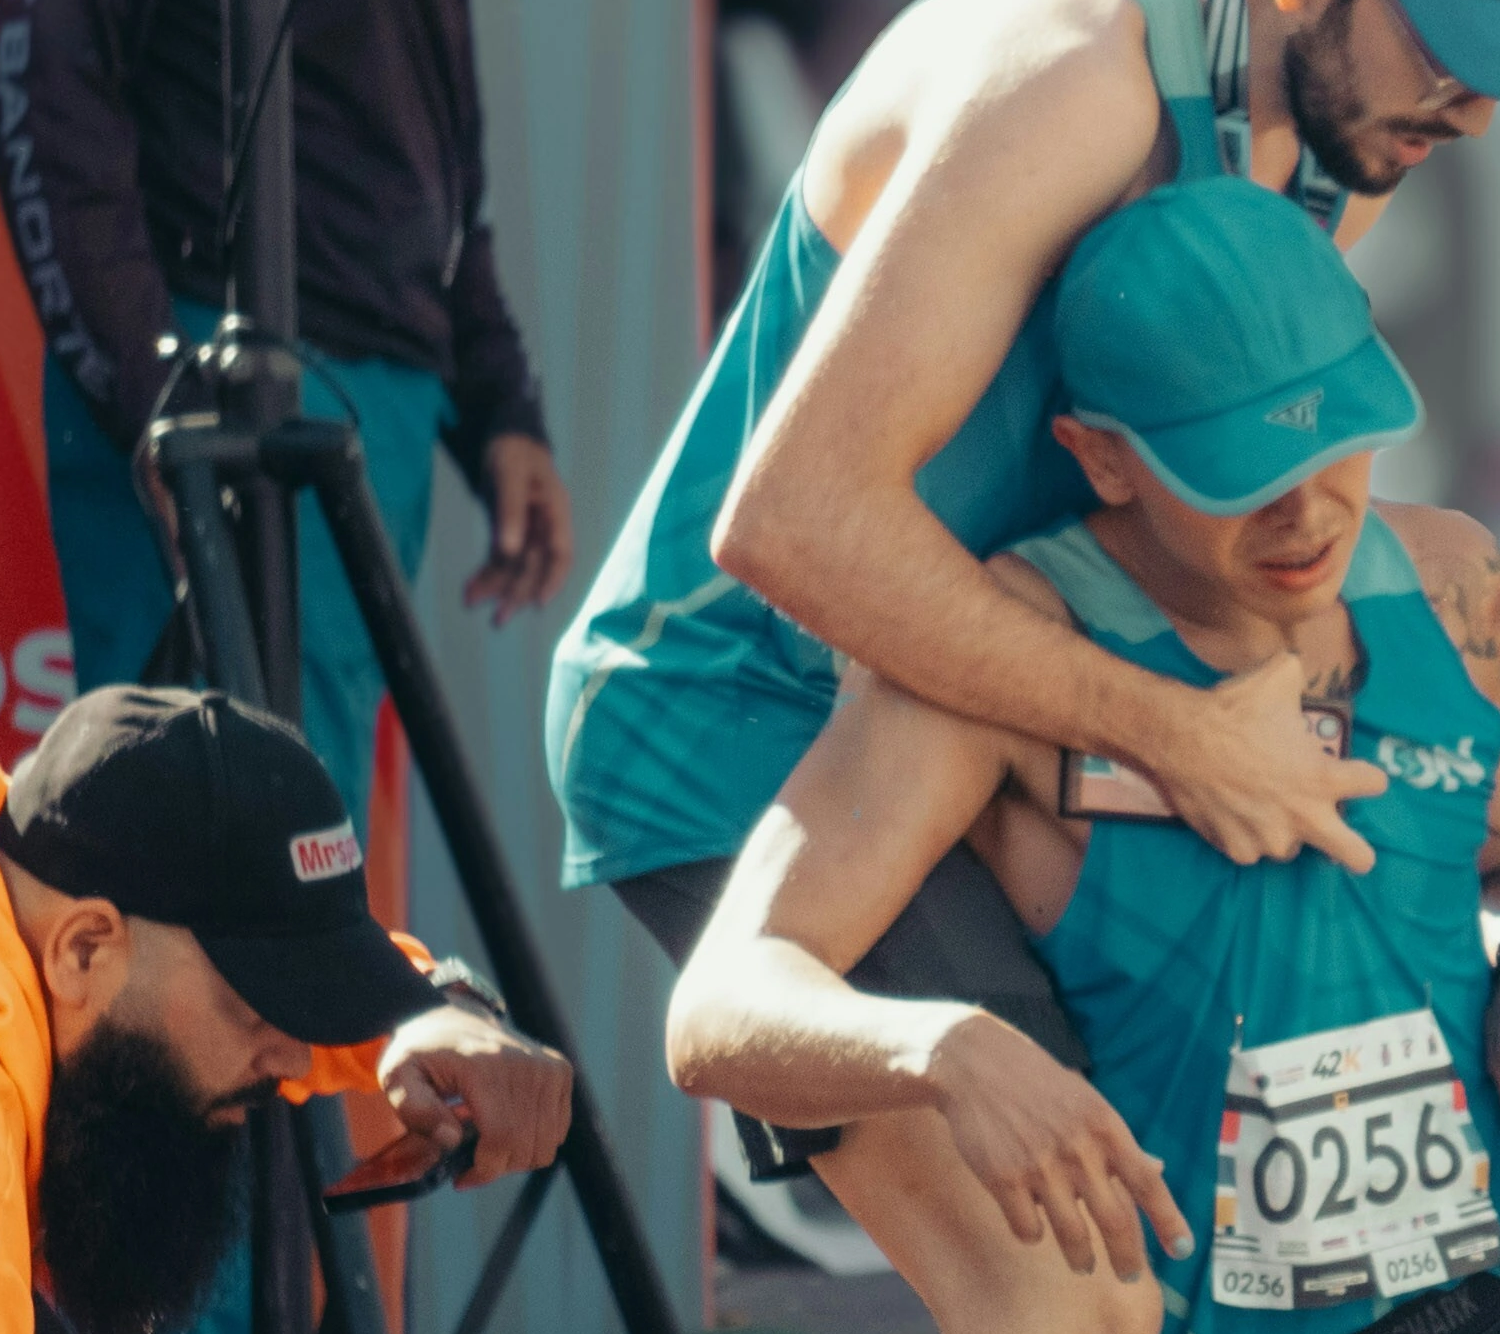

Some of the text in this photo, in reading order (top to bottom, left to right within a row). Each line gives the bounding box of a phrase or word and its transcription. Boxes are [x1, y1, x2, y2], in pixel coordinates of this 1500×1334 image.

[1311, 1045, 1364, 1079] 42K
[1253, 1103, 1463, 1226] 0256
[1222, 1271, 1285, 1298] 0256
[1385, 1254, 1438, 1284] 0256
